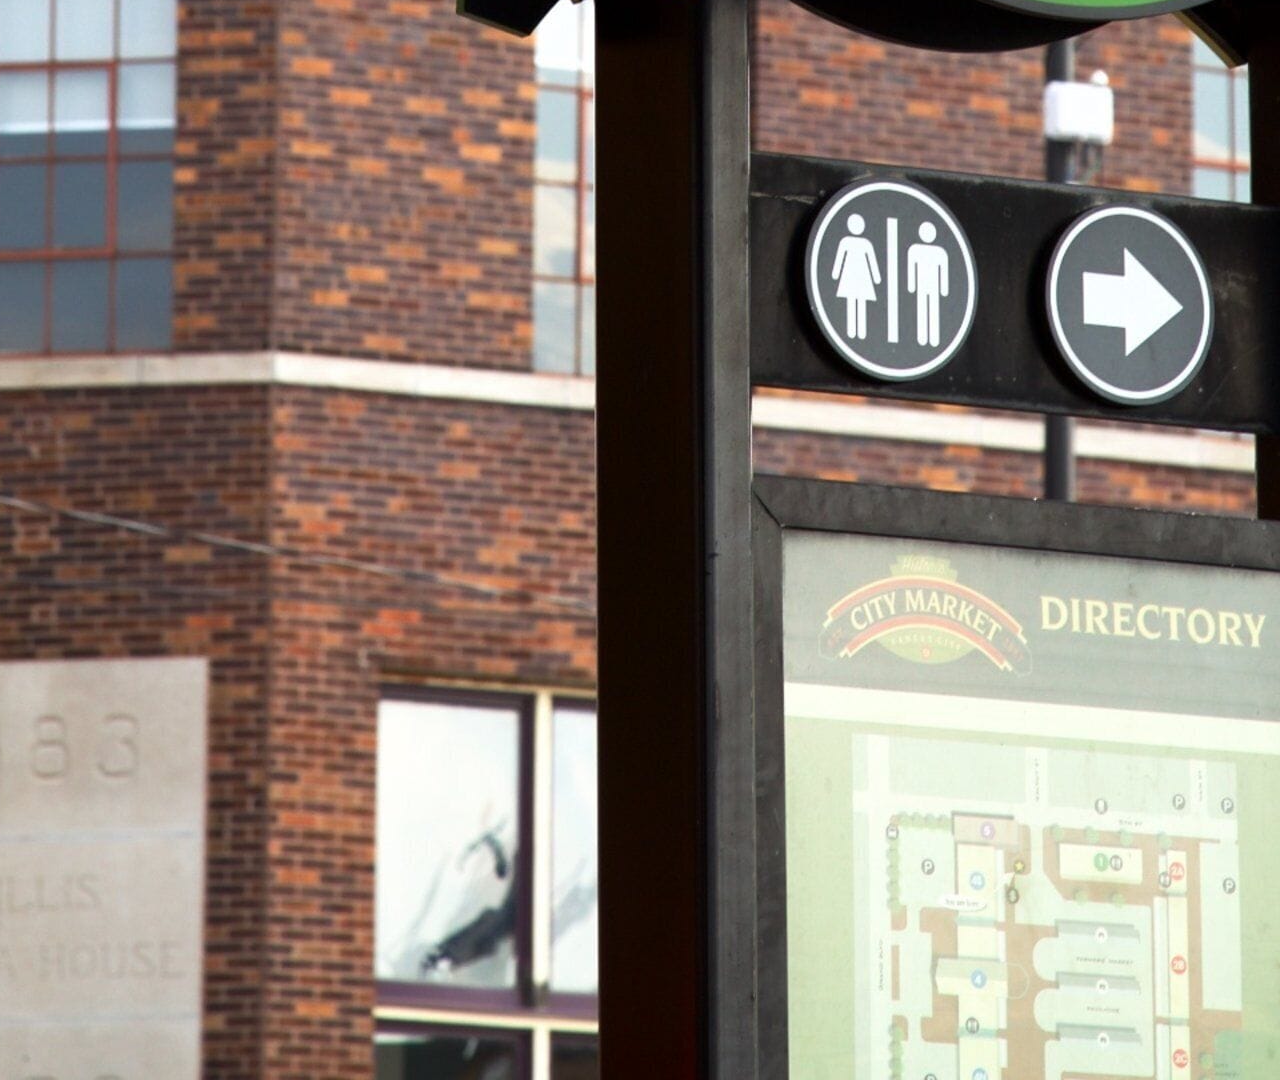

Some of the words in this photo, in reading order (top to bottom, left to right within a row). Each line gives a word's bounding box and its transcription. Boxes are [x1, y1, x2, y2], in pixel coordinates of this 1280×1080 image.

[850, 590, 897, 631] CITY
[905, 589, 1004, 641] MARKET
[1040, 595, 1268, 649] DIRECTORY
[40, 940, 187, 981] HOUSE
